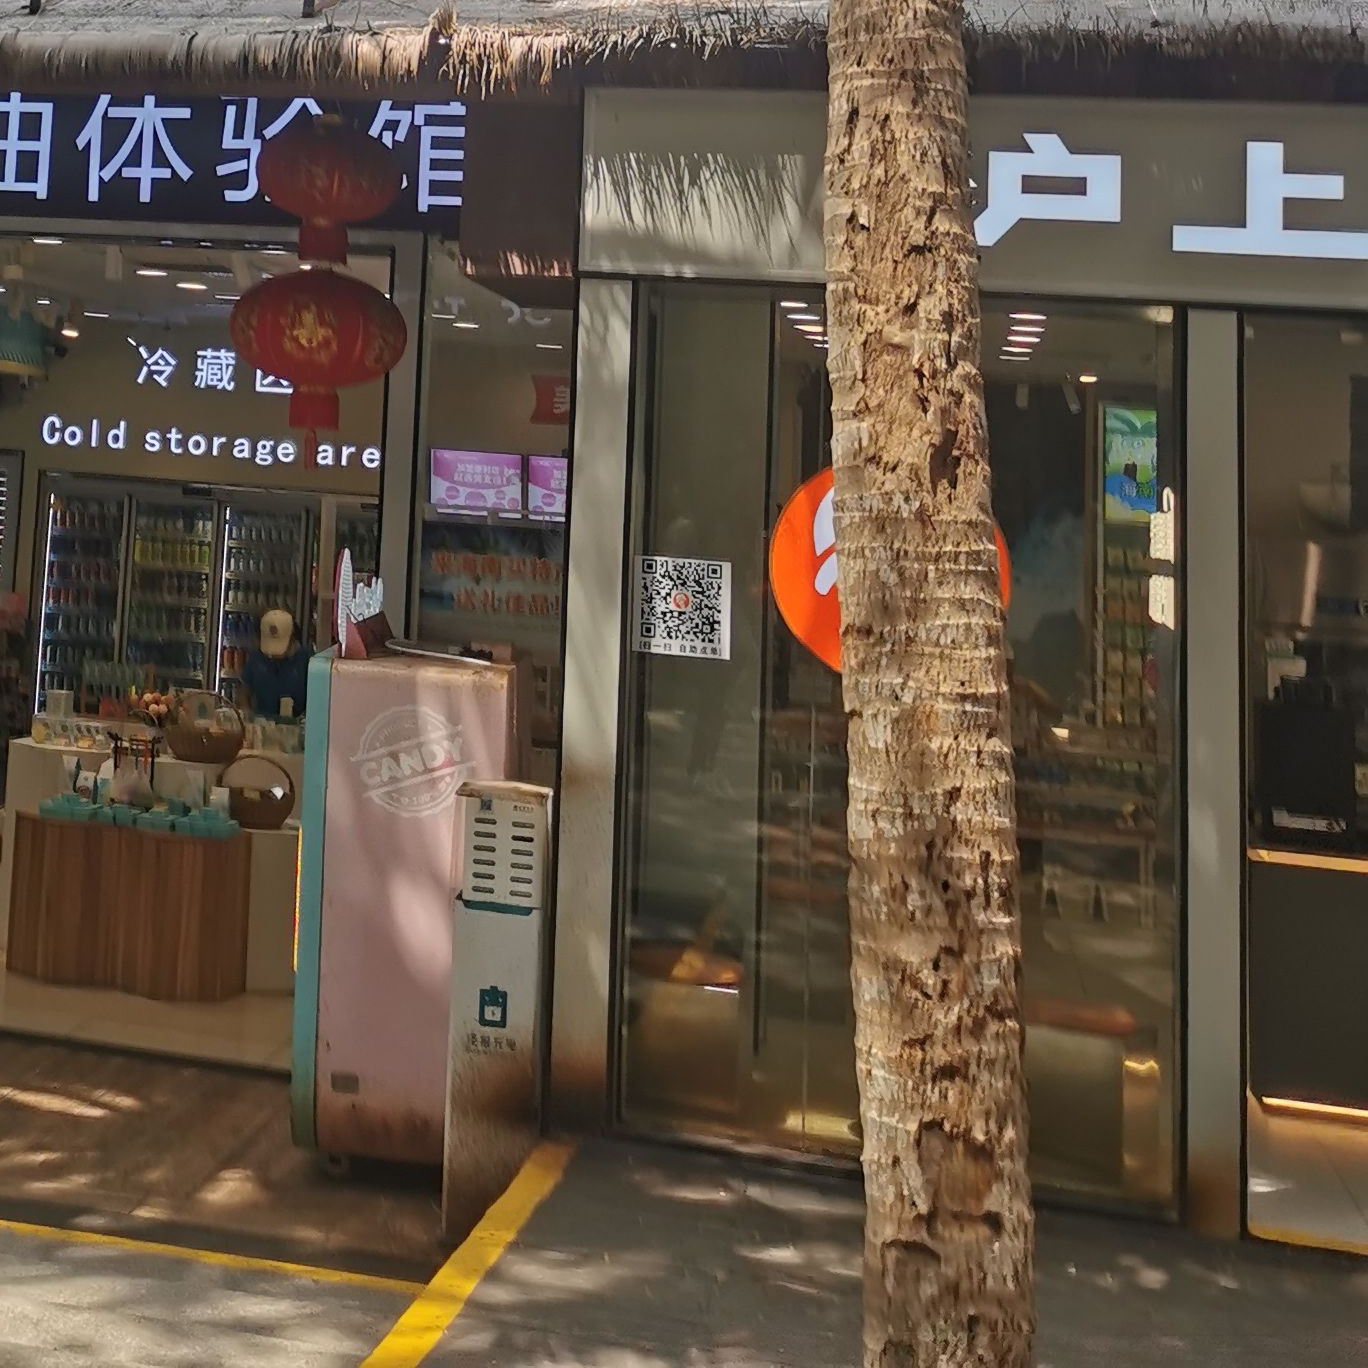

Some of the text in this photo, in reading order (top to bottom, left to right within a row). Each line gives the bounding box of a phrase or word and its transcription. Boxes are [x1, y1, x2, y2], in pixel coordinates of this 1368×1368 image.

[41, 414, 128, 450] Cold
[144, 426, 296, 466] storage
[359, 738, 463, 784] CANDY
